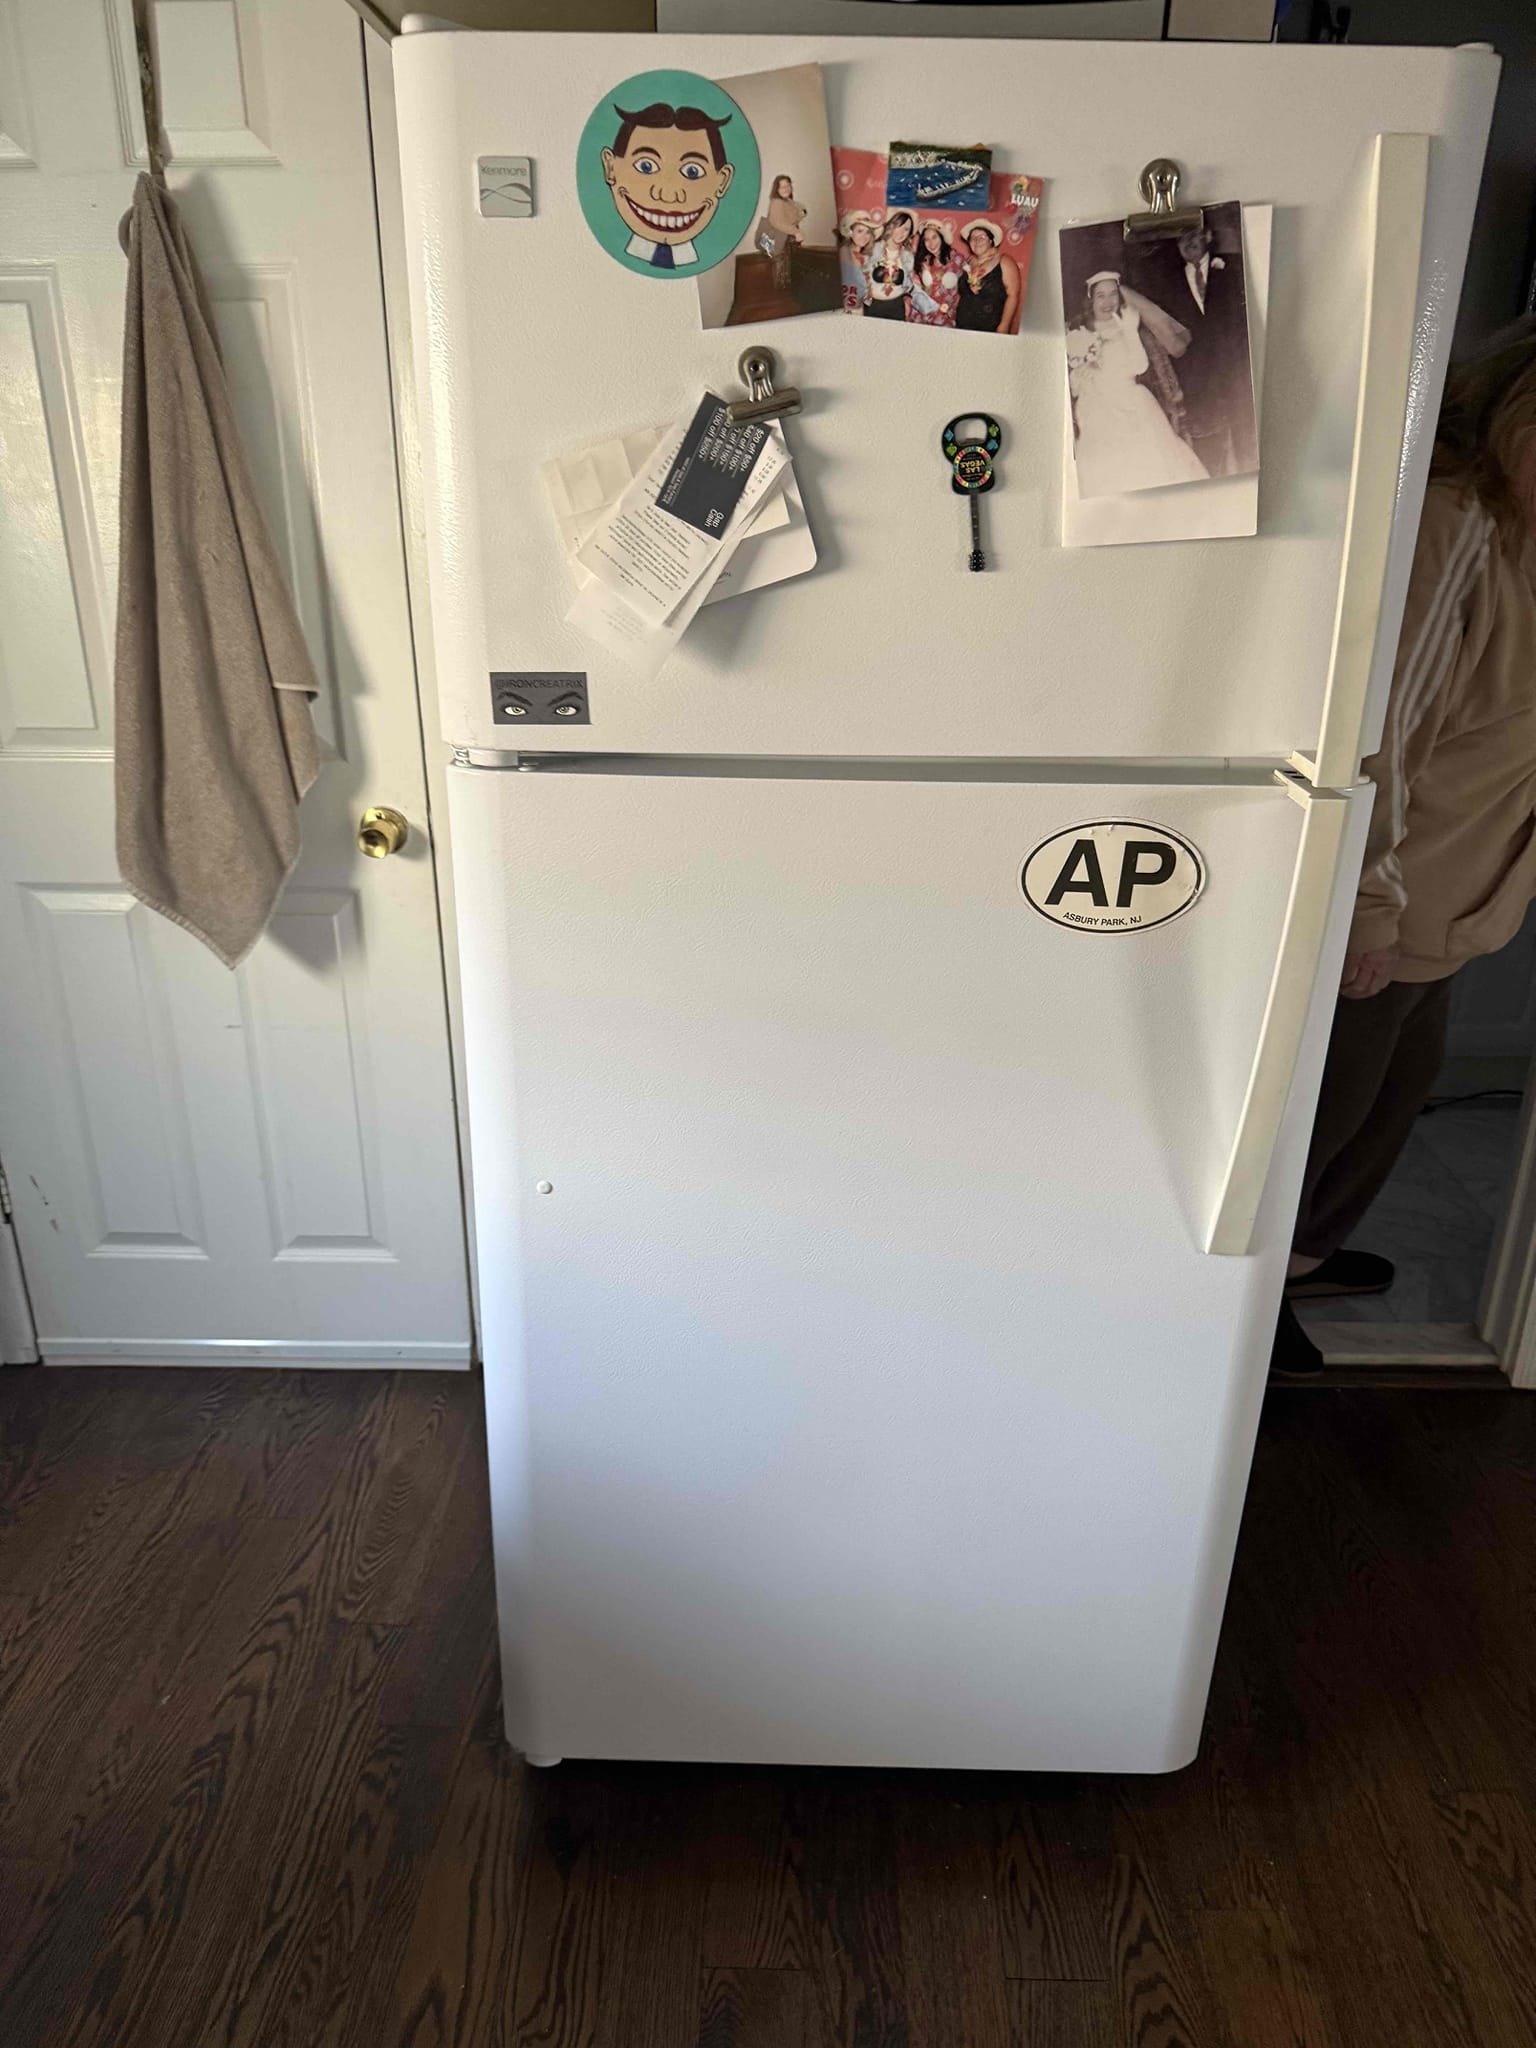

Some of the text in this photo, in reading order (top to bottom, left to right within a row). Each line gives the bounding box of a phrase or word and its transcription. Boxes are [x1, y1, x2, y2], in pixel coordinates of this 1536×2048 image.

[1011, 193, 1039, 208] LUAU
[712, 407, 727, 426] $100
[707, 425, 716, 438] off
[718, 427, 728, 440] off
[728, 432, 738, 445] off
[752, 428, 765, 444] $20
[738, 437, 747, 450] off
[746, 442, 757, 455] off
[728, 448, 743, 470] $100+
[960, 460, 986, 468] VEGAS
[1044, 839, 1177, 908] AP
[1063, 912, 1142, 927] ASBURY PARK, NJ
